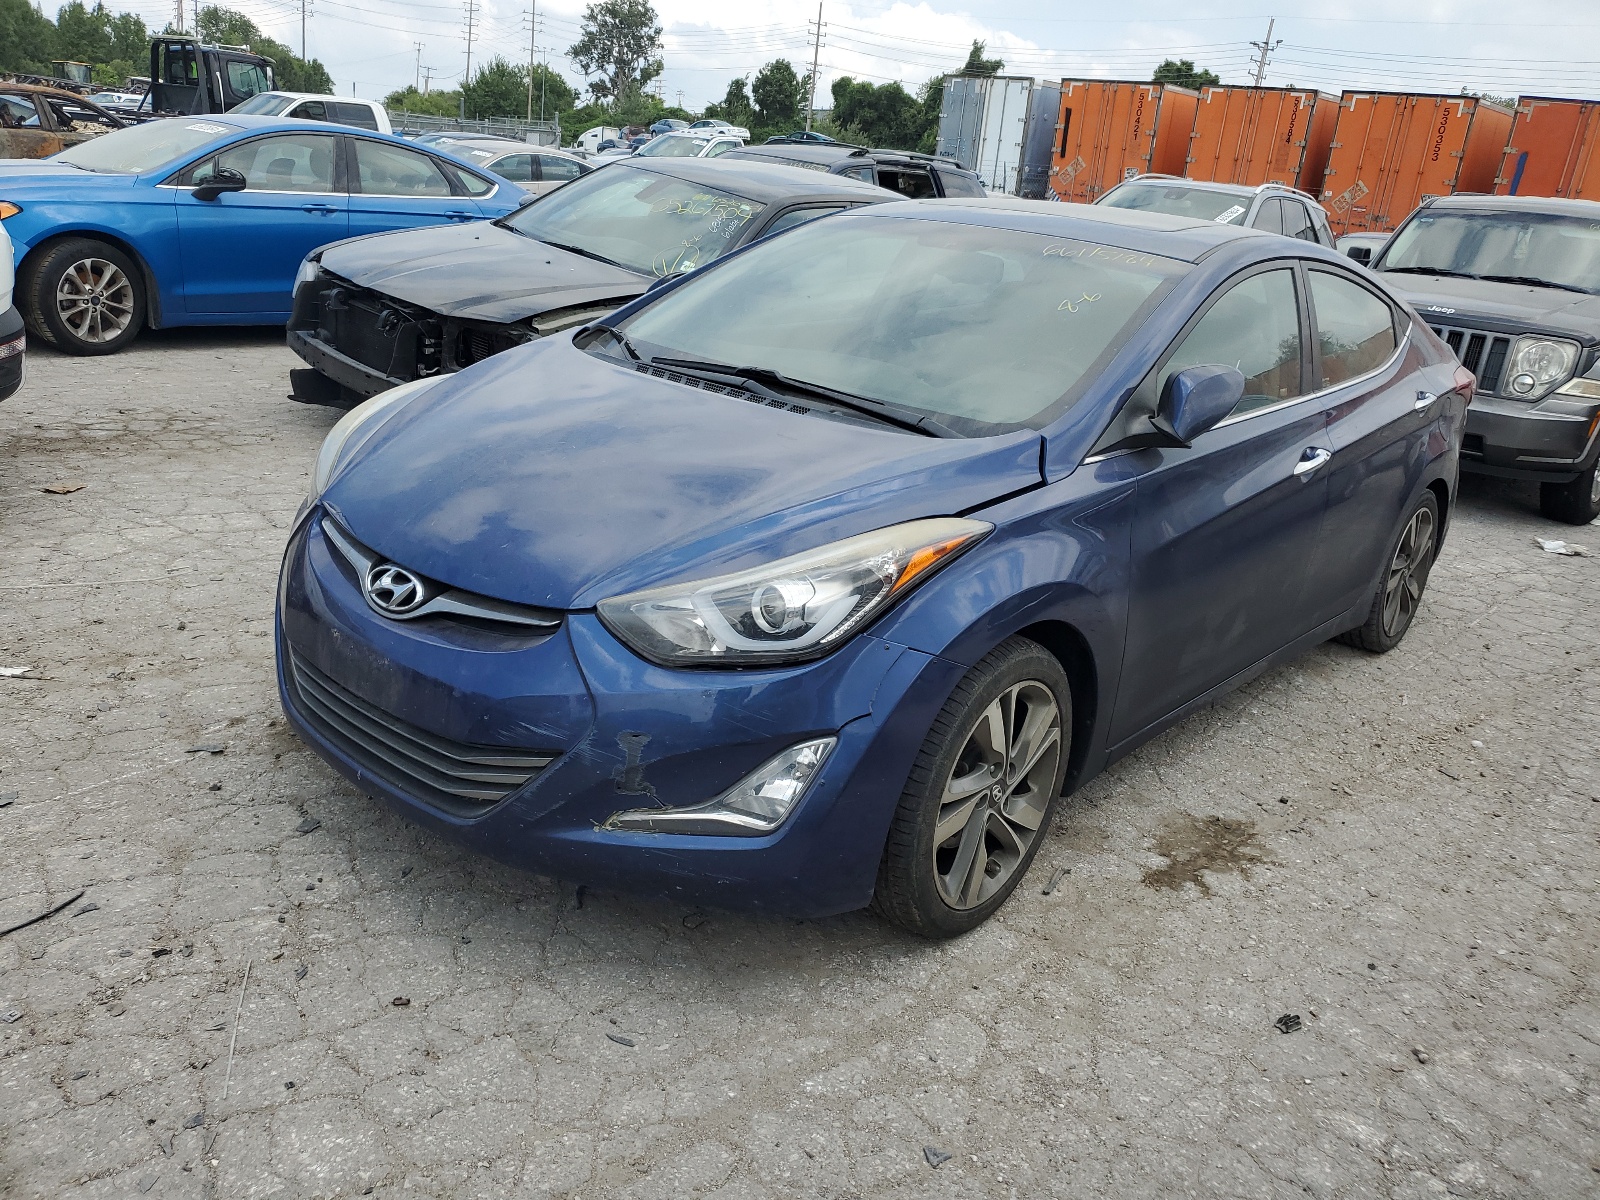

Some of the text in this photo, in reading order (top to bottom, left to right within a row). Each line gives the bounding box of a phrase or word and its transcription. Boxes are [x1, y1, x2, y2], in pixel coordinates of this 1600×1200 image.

[1133, 92, 1145, 141] 530421
[1285, 96, 1300, 144] 530584
[1431, 107, 1451, 162] 530353
[1427, 305, 1456, 315] Jeep
